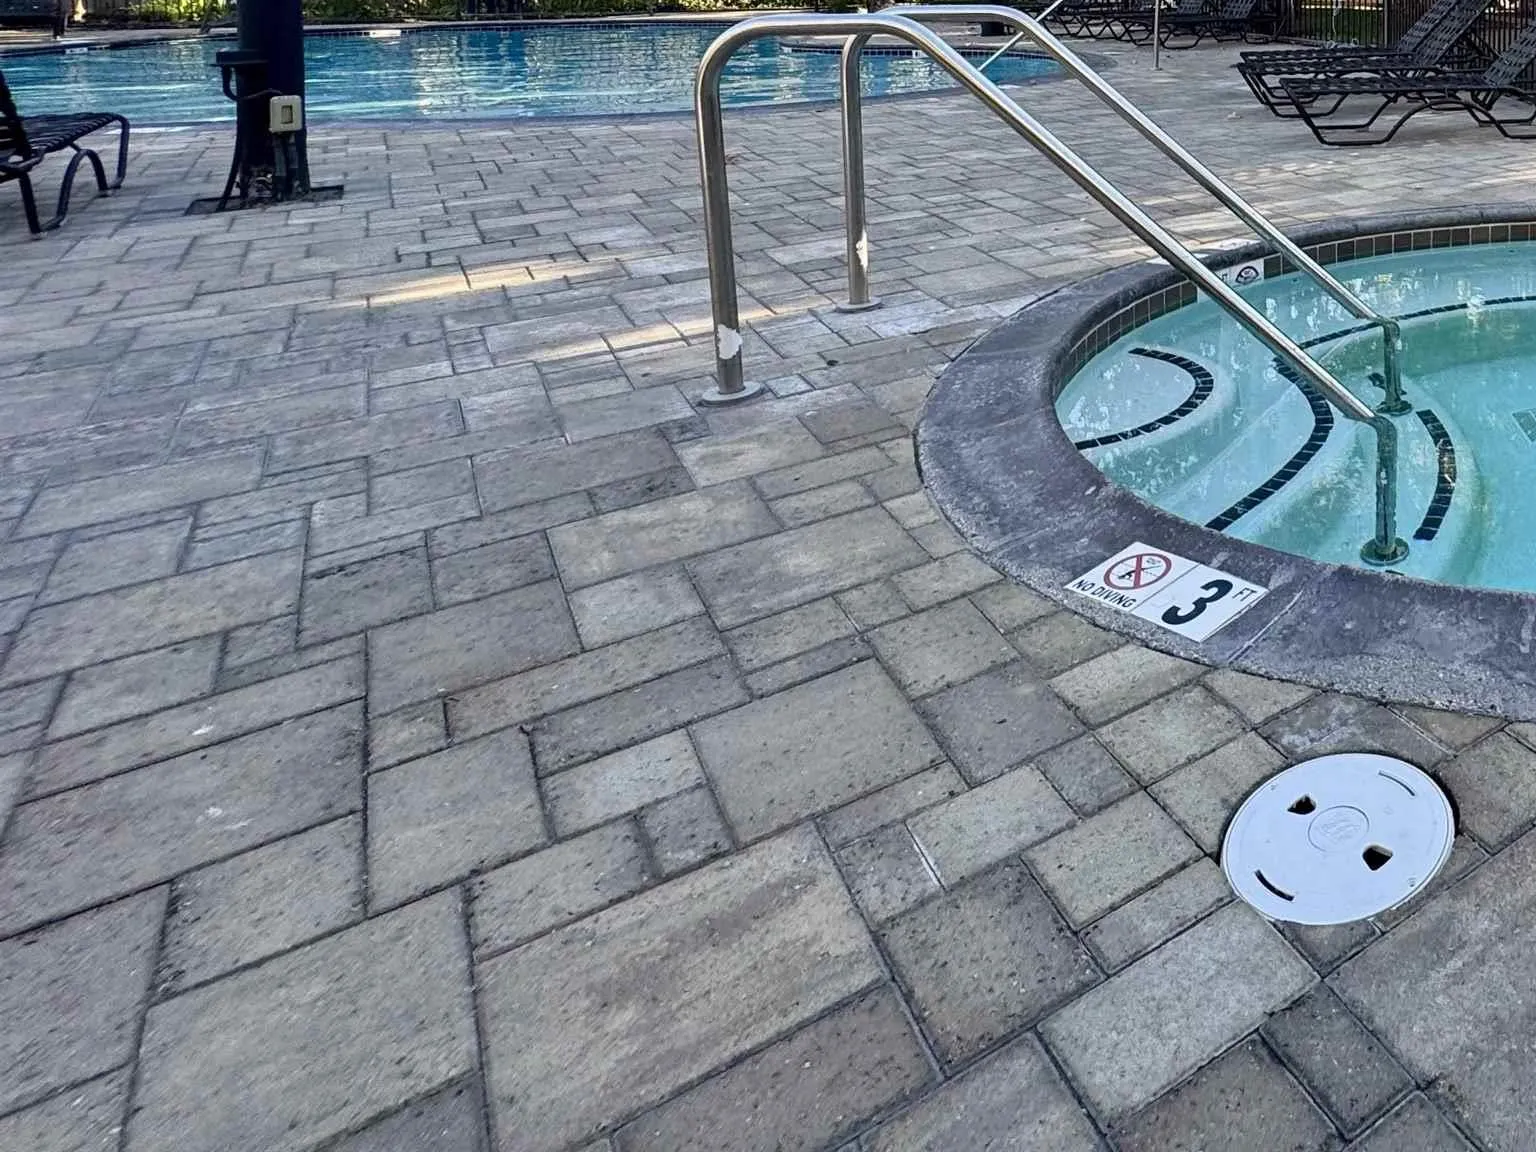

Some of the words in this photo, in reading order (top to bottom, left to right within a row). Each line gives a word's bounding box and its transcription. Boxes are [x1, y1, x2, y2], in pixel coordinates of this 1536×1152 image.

[1072, 579, 1096, 591] NO
[1090, 586, 1137, 608] DIVING
[1161, 579, 1233, 625] 3
[1232, 587, 1257, 603] FT
